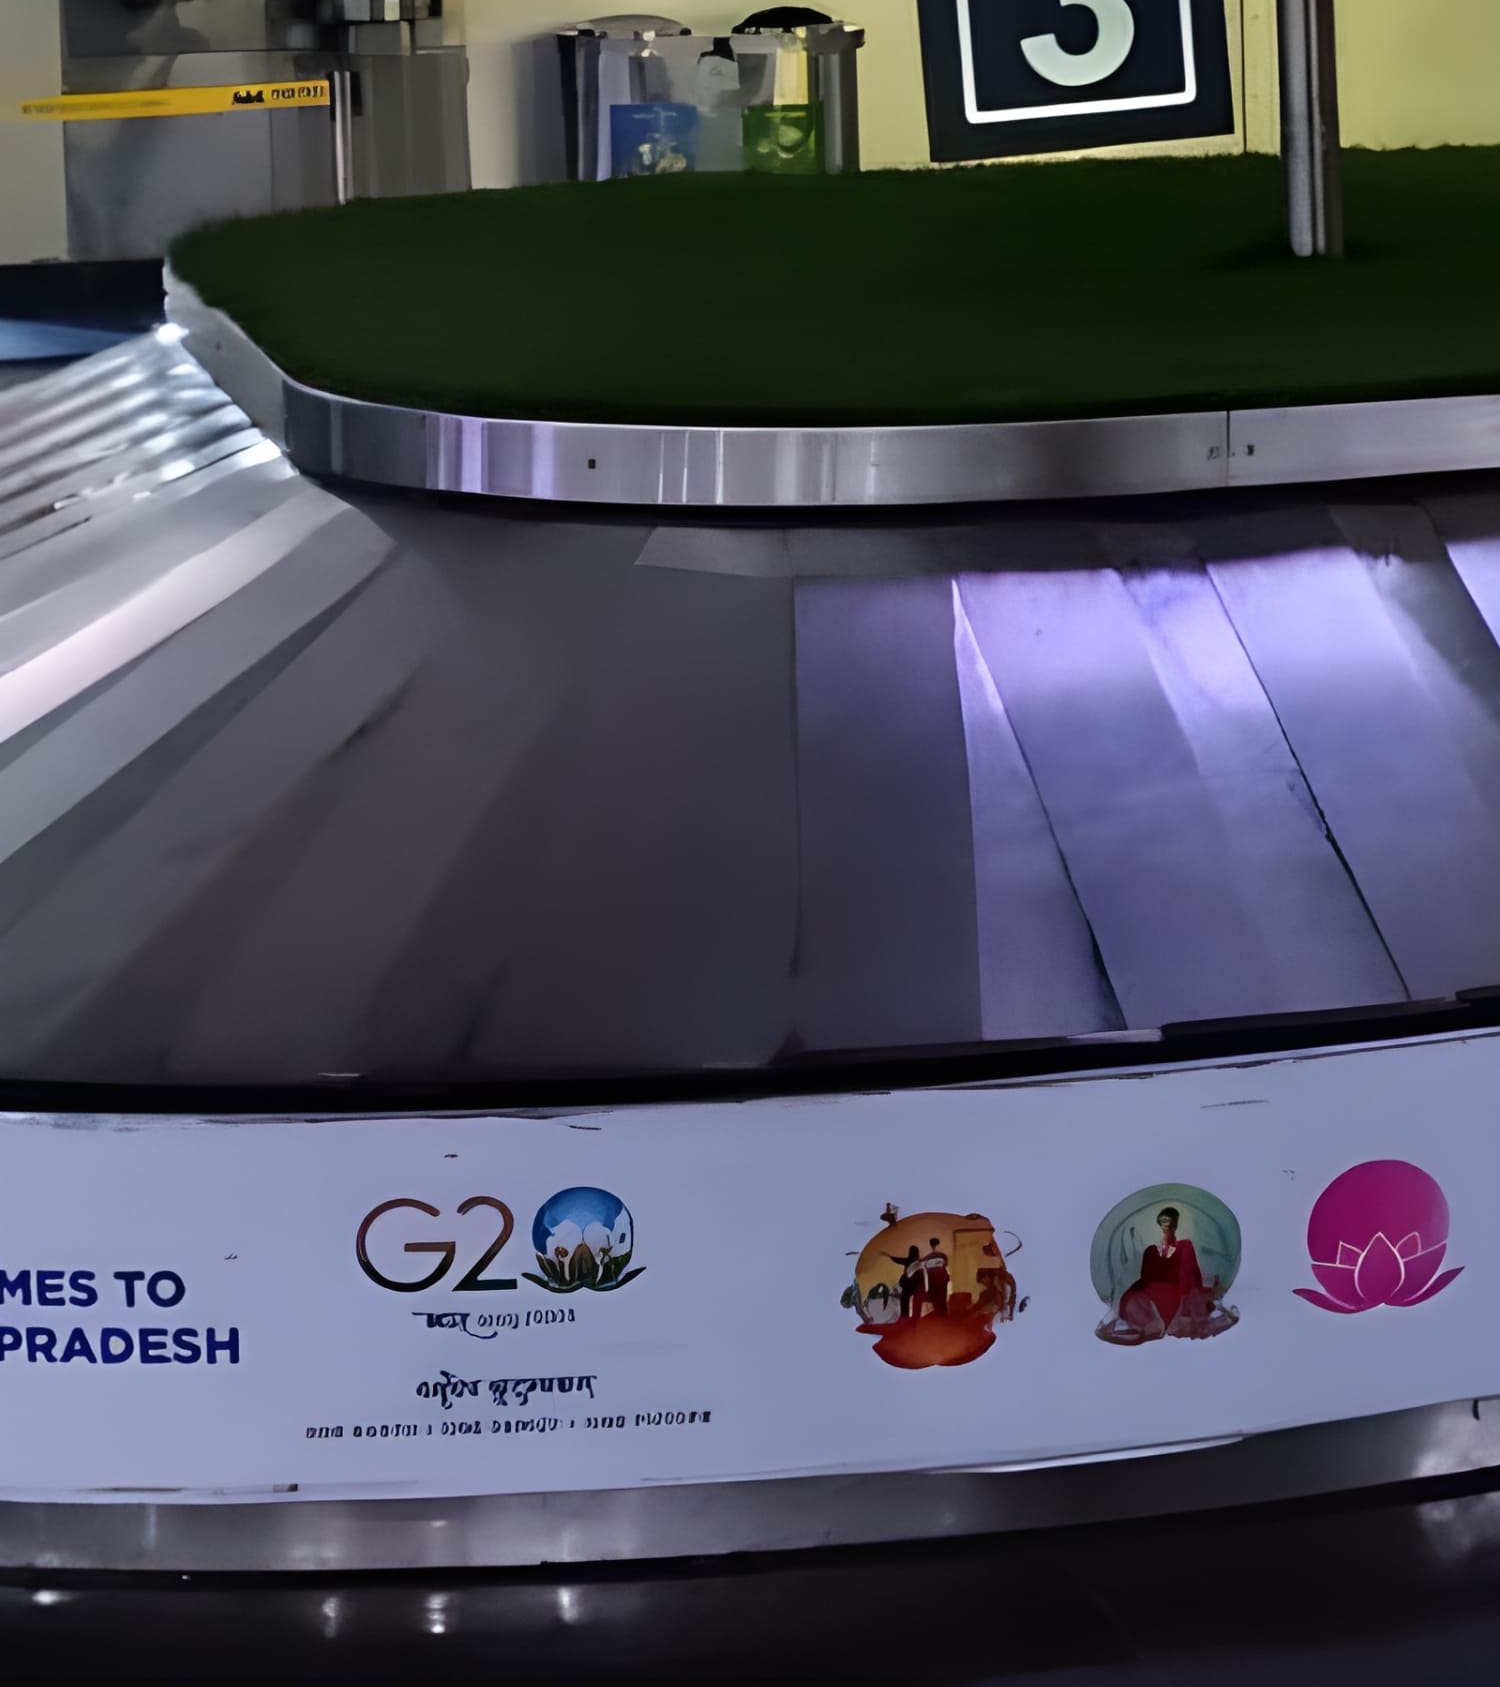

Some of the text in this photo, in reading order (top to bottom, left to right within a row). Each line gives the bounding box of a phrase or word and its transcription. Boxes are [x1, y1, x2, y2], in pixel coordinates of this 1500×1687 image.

[0, 1269, 186, 1308] MES TO
[0, 1326, 240, 1364] PRADESH
